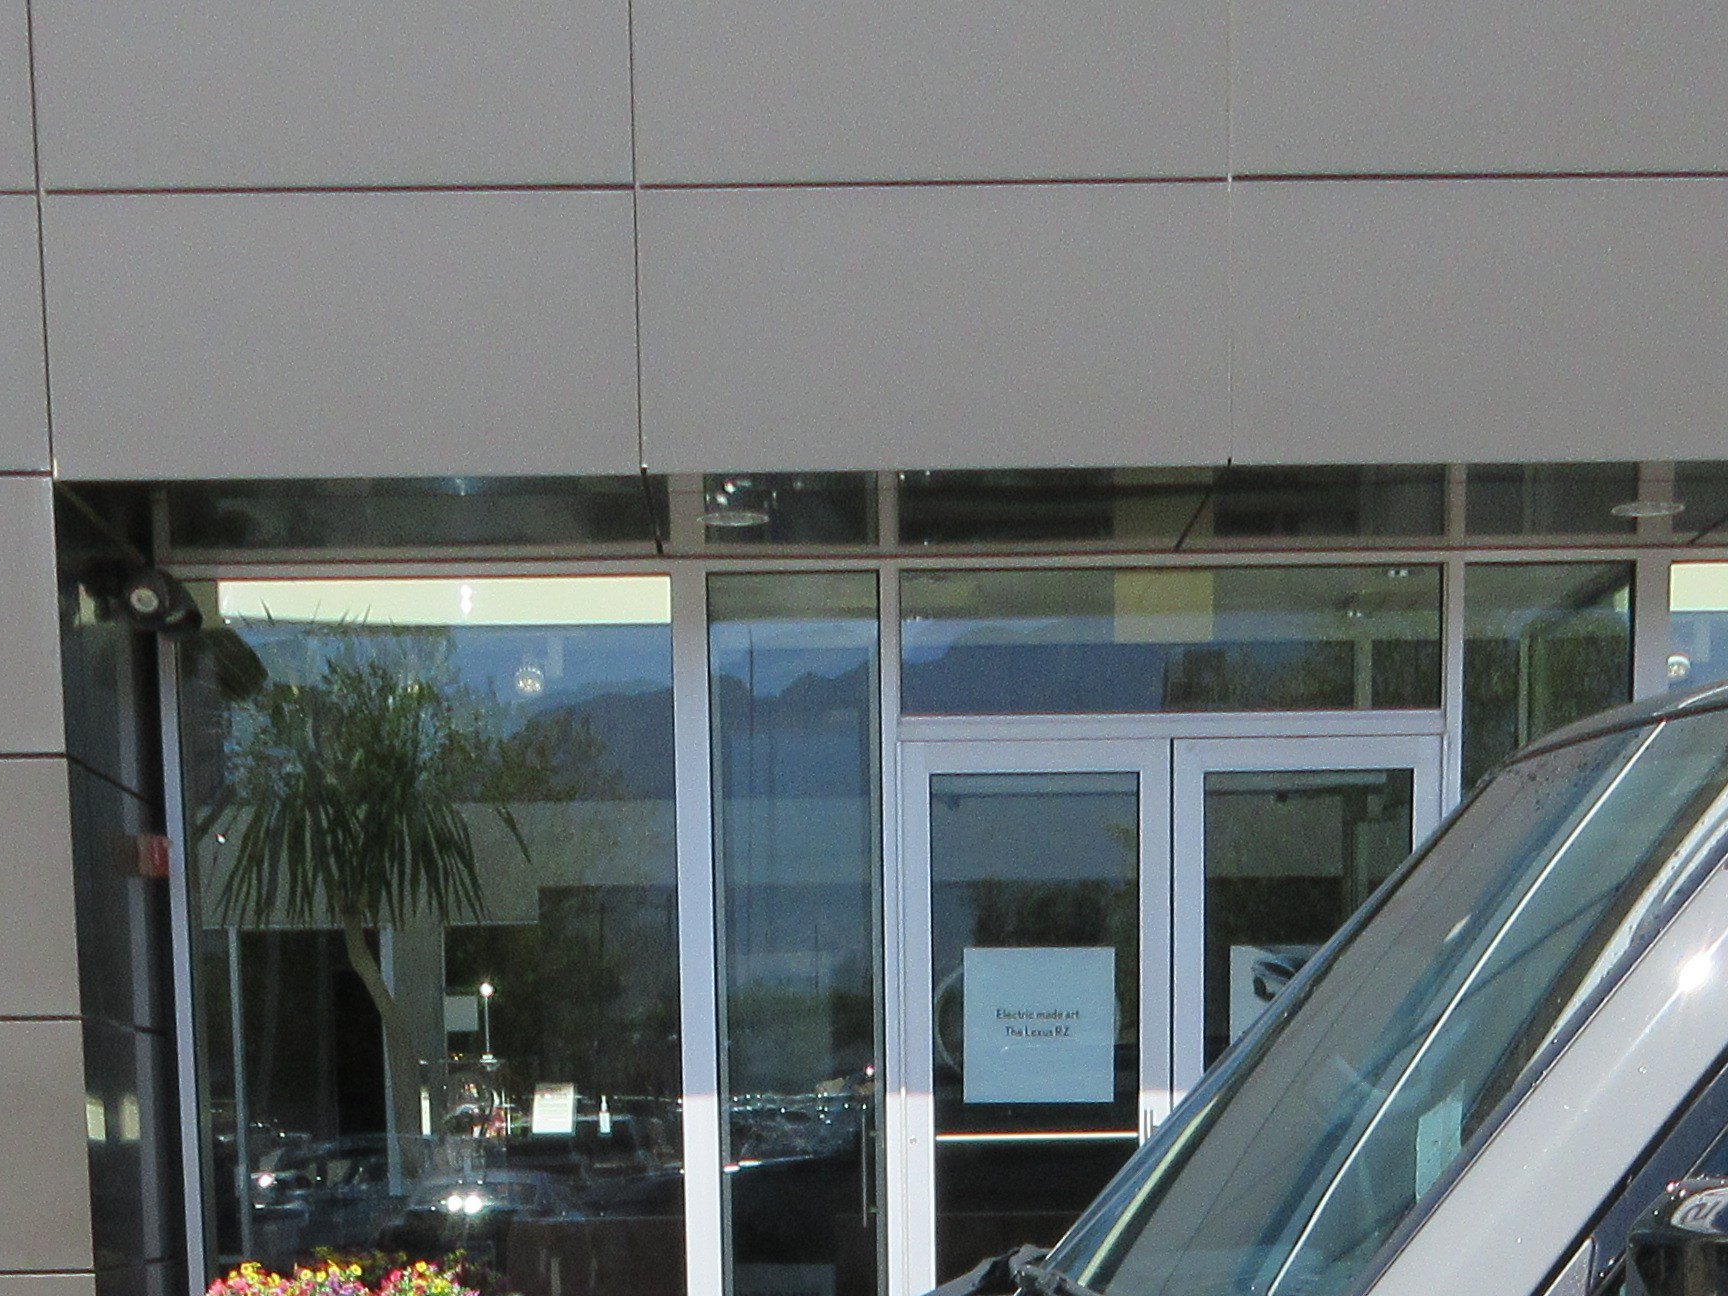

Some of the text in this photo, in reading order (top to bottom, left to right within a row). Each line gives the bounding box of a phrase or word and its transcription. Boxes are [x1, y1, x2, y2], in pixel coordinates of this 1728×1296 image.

[996, 1008, 1079, 1019] Electric made art
[1005, 1025, 1070, 1037] The Lexus RZ
